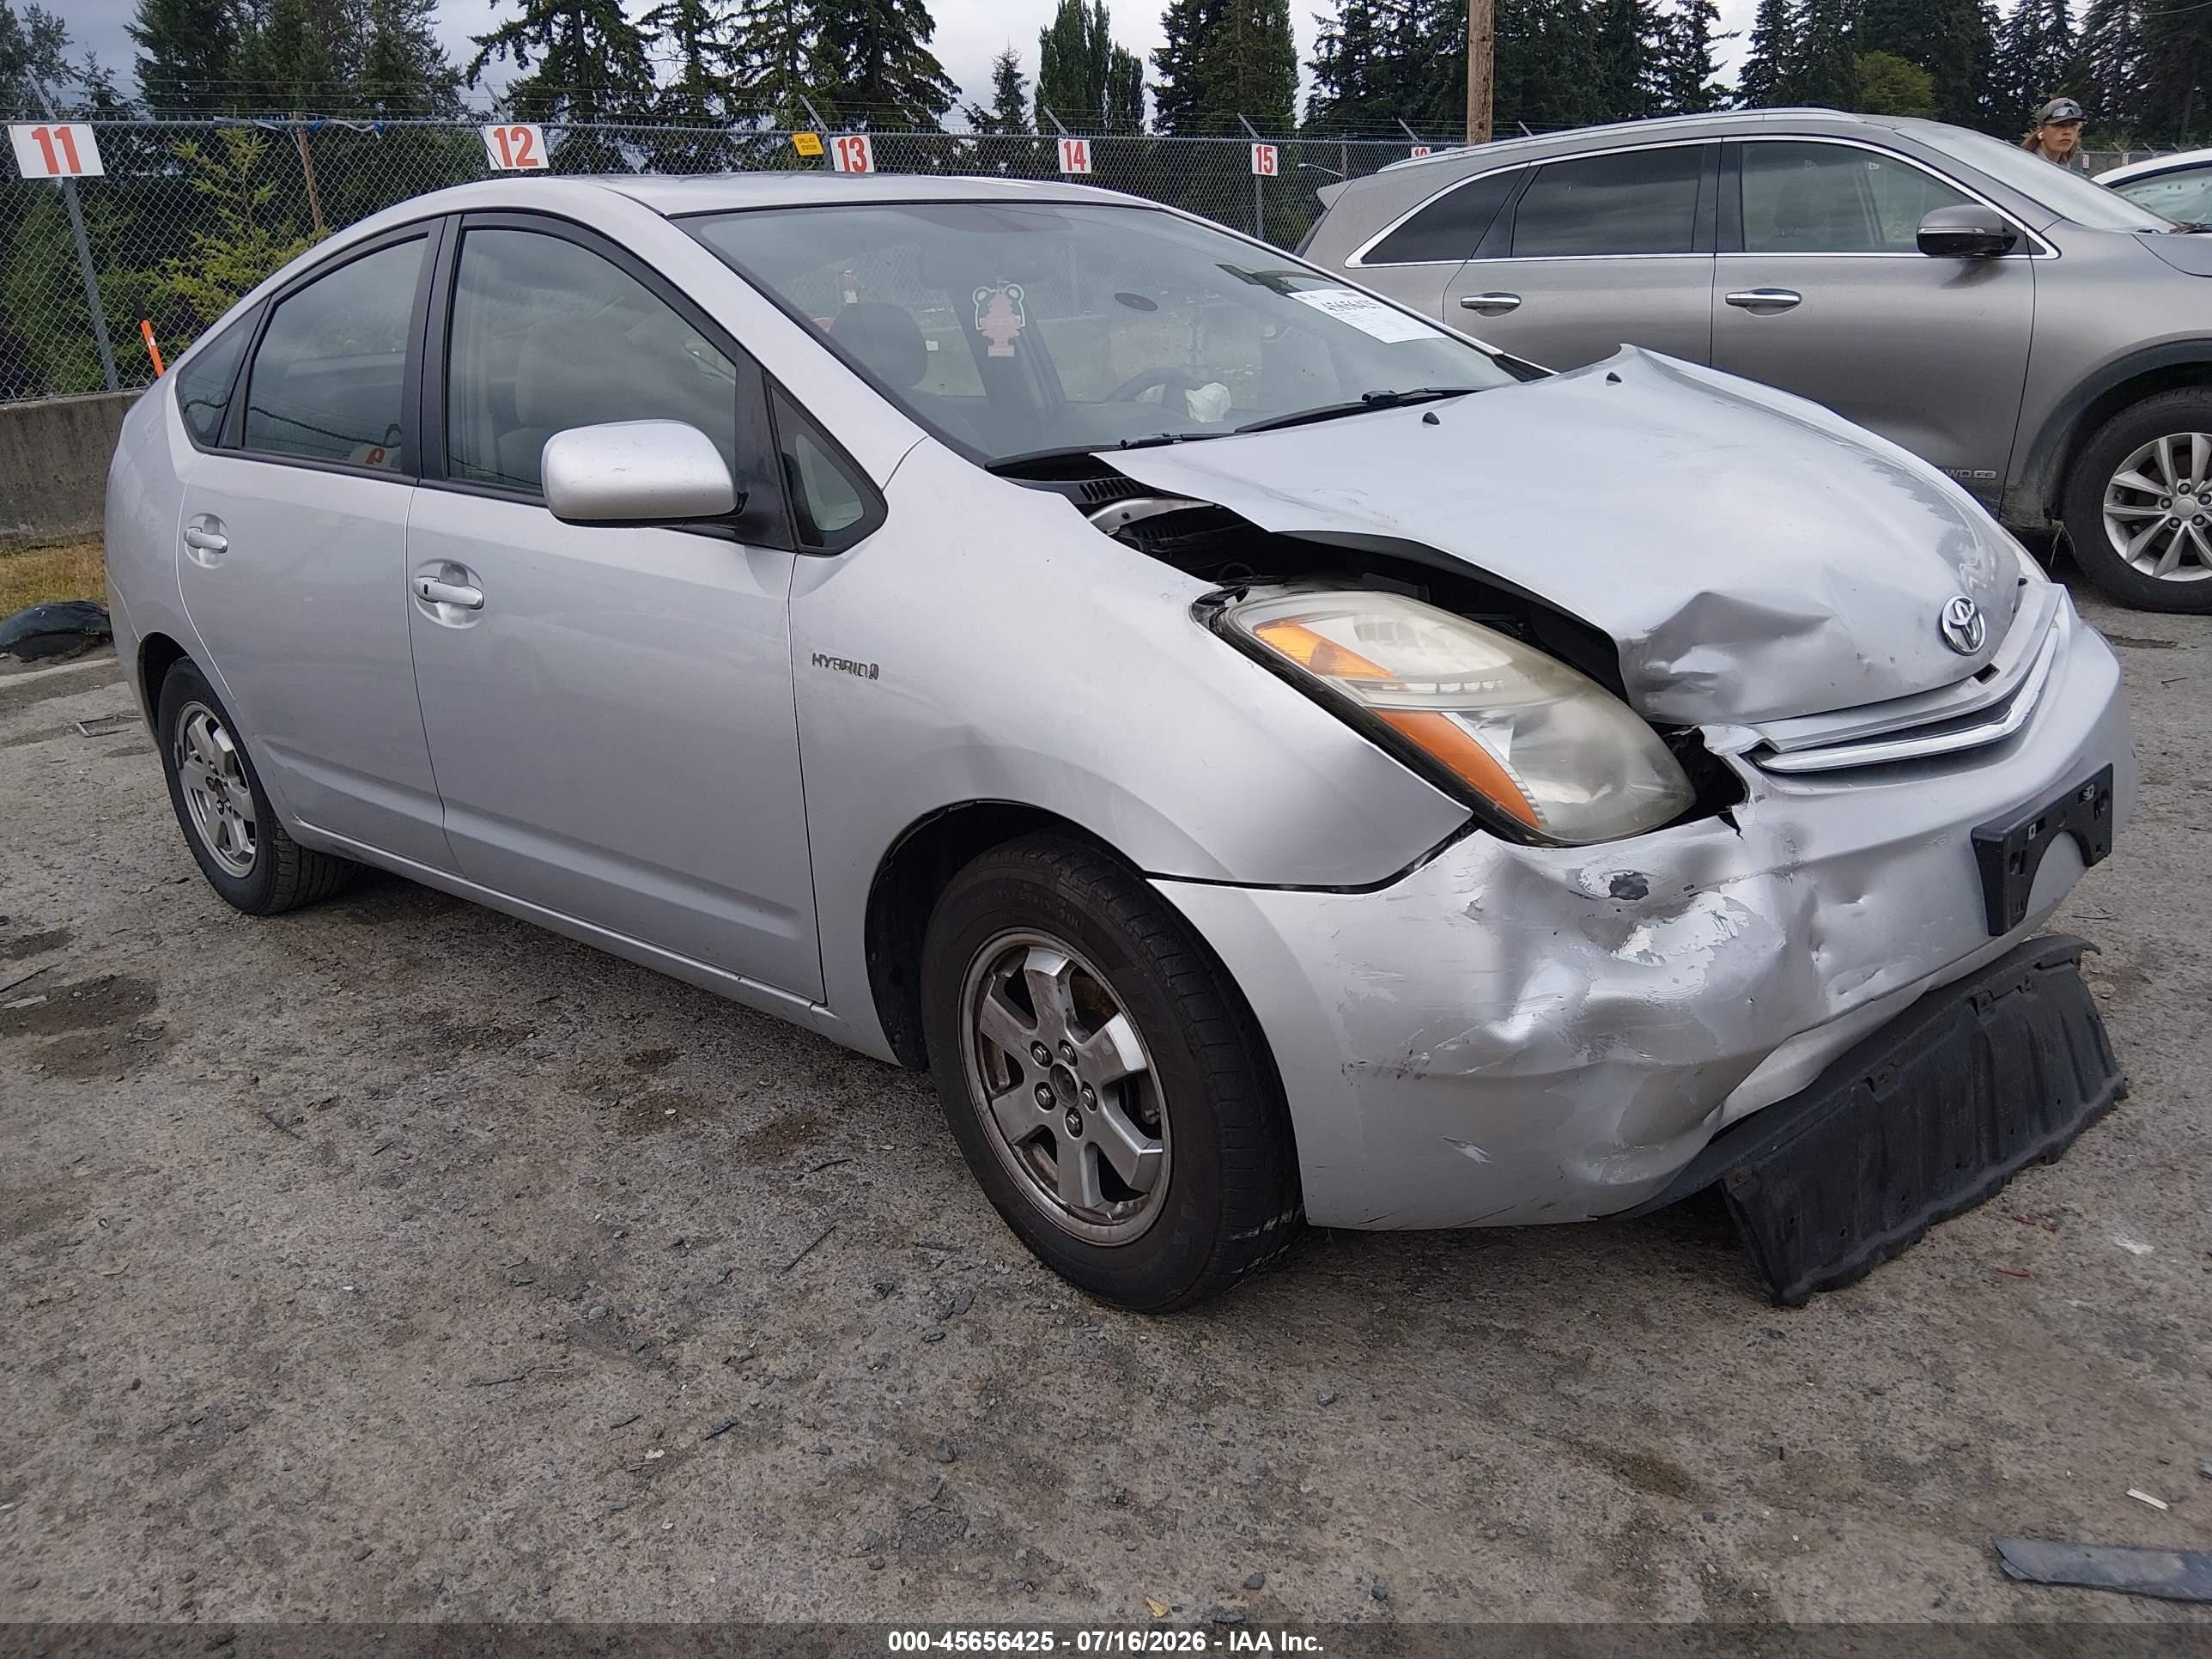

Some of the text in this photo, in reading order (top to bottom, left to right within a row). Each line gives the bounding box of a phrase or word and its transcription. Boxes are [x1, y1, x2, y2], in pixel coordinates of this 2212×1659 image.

[32, 126, 81, 174] 11
[494, 126, 538, 167] 12
[837, 137, 868, 173] 13
[1063, 141, 1087, 172] 14
[1255, 146, 1274, 174] 15
[1942, 468, 1972, 478] WD
[811, 652, 868, 678] HYBRID
